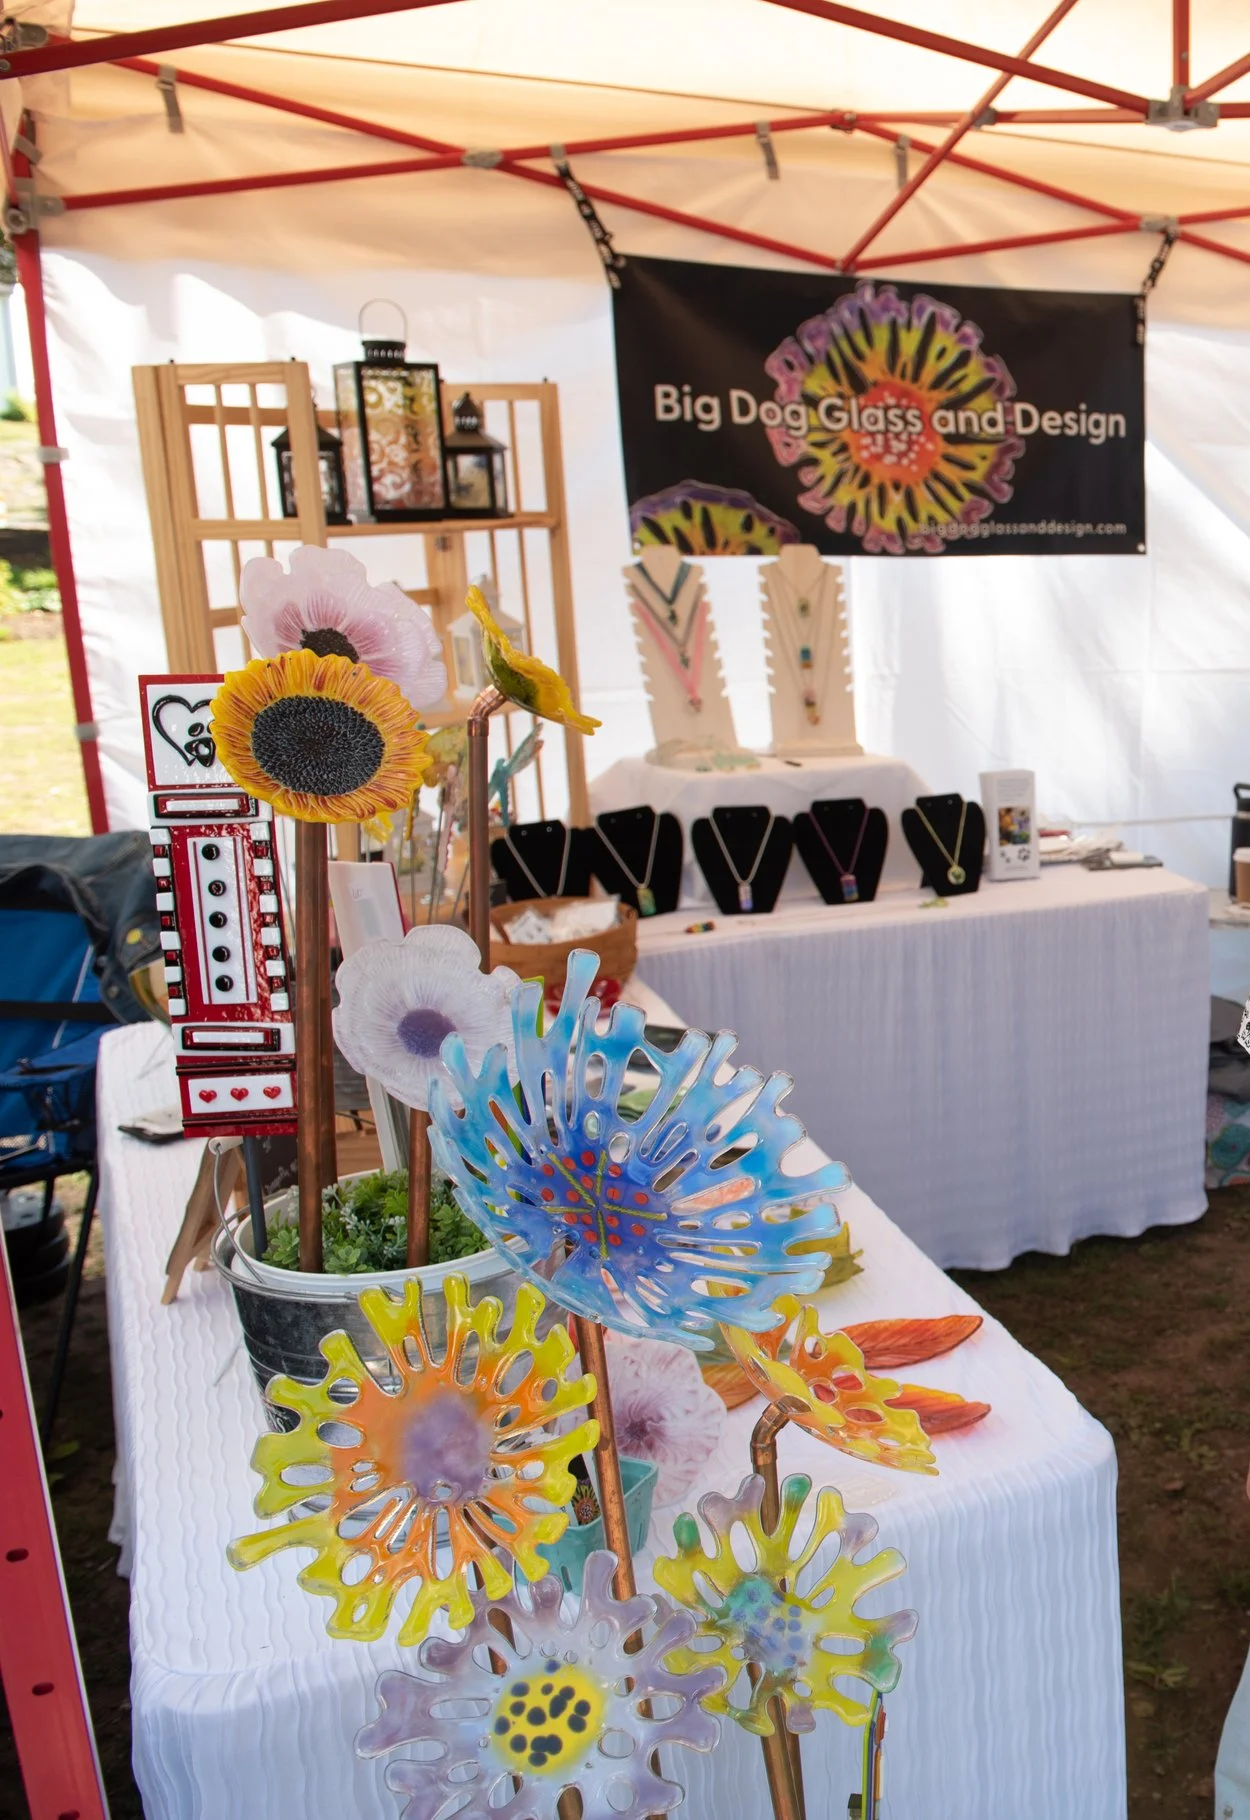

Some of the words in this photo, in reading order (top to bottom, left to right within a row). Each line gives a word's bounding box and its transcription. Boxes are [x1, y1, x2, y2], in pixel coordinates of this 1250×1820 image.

[654, 384, 722, 431] Big
[729, 389, 809, 436] Dog
[818, 397, 923, 433] Glass
[931, 402, 1005, 434] and
[1013, 402, 1126, 444] Design
